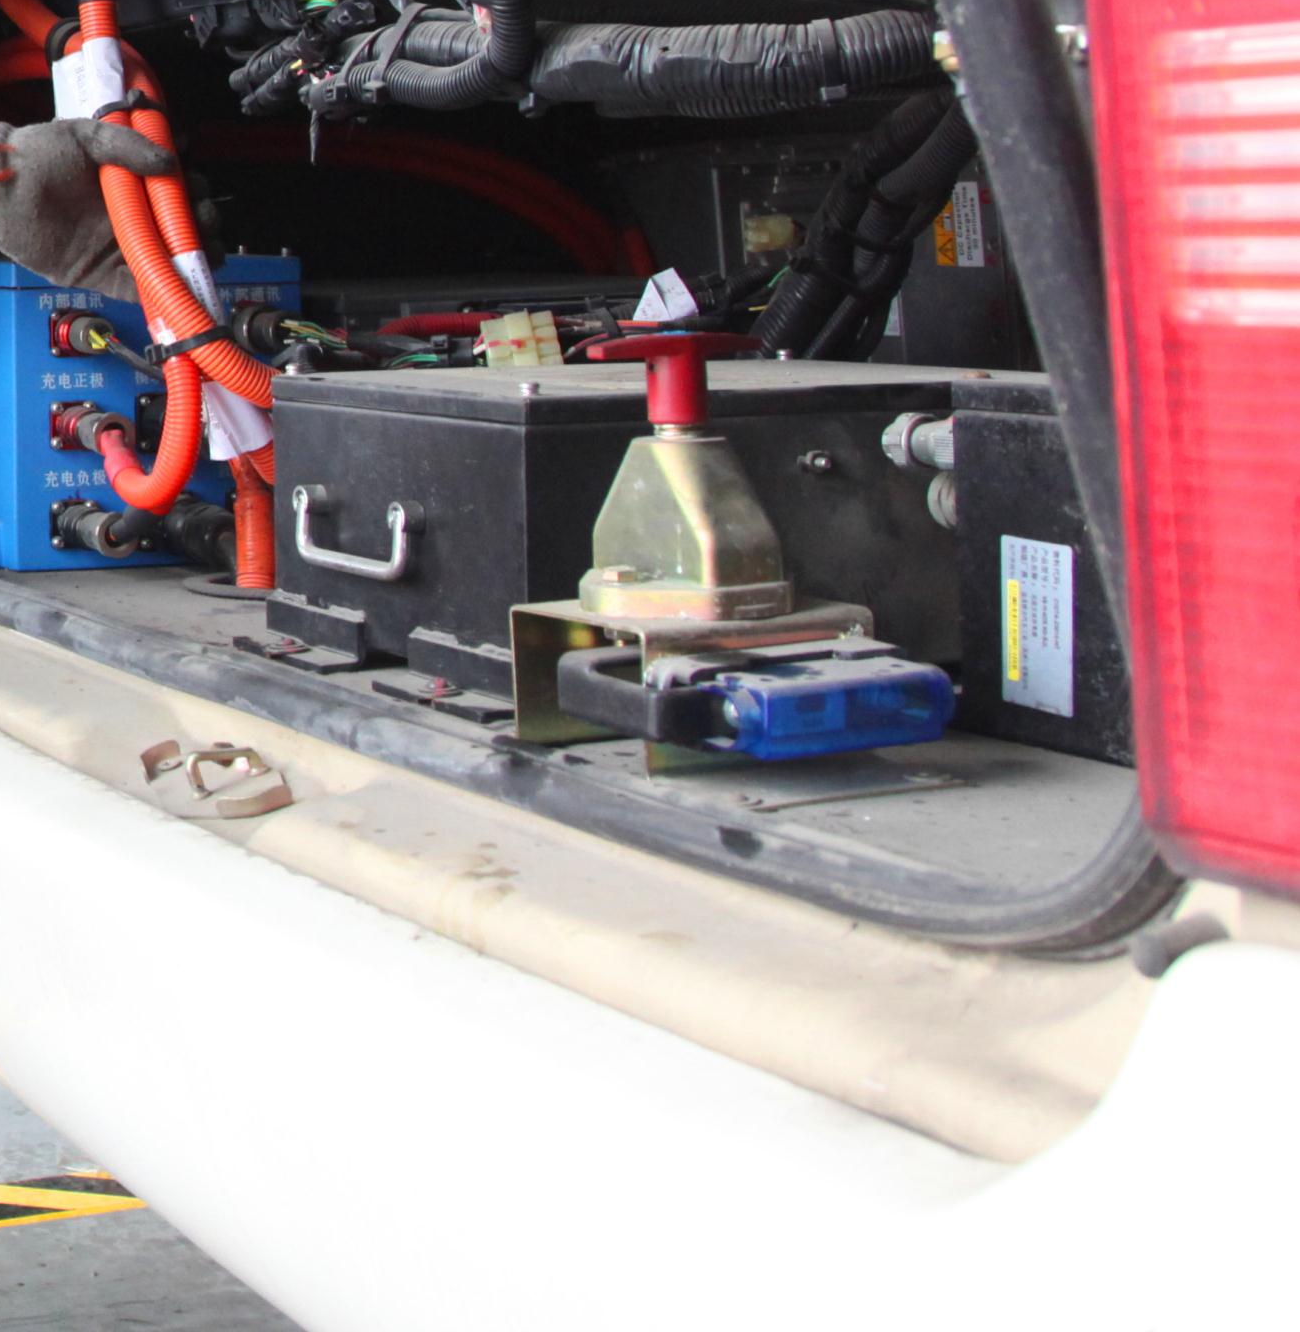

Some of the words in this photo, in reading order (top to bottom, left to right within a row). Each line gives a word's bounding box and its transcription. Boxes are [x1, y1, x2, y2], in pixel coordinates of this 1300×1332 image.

[963, 212, 973, 261] Discharge
[39, 292, 105, 310] 内部通讯
[41, 372, 104, 389] 充电正极
[44, 470, 107, 488] 充电负极
